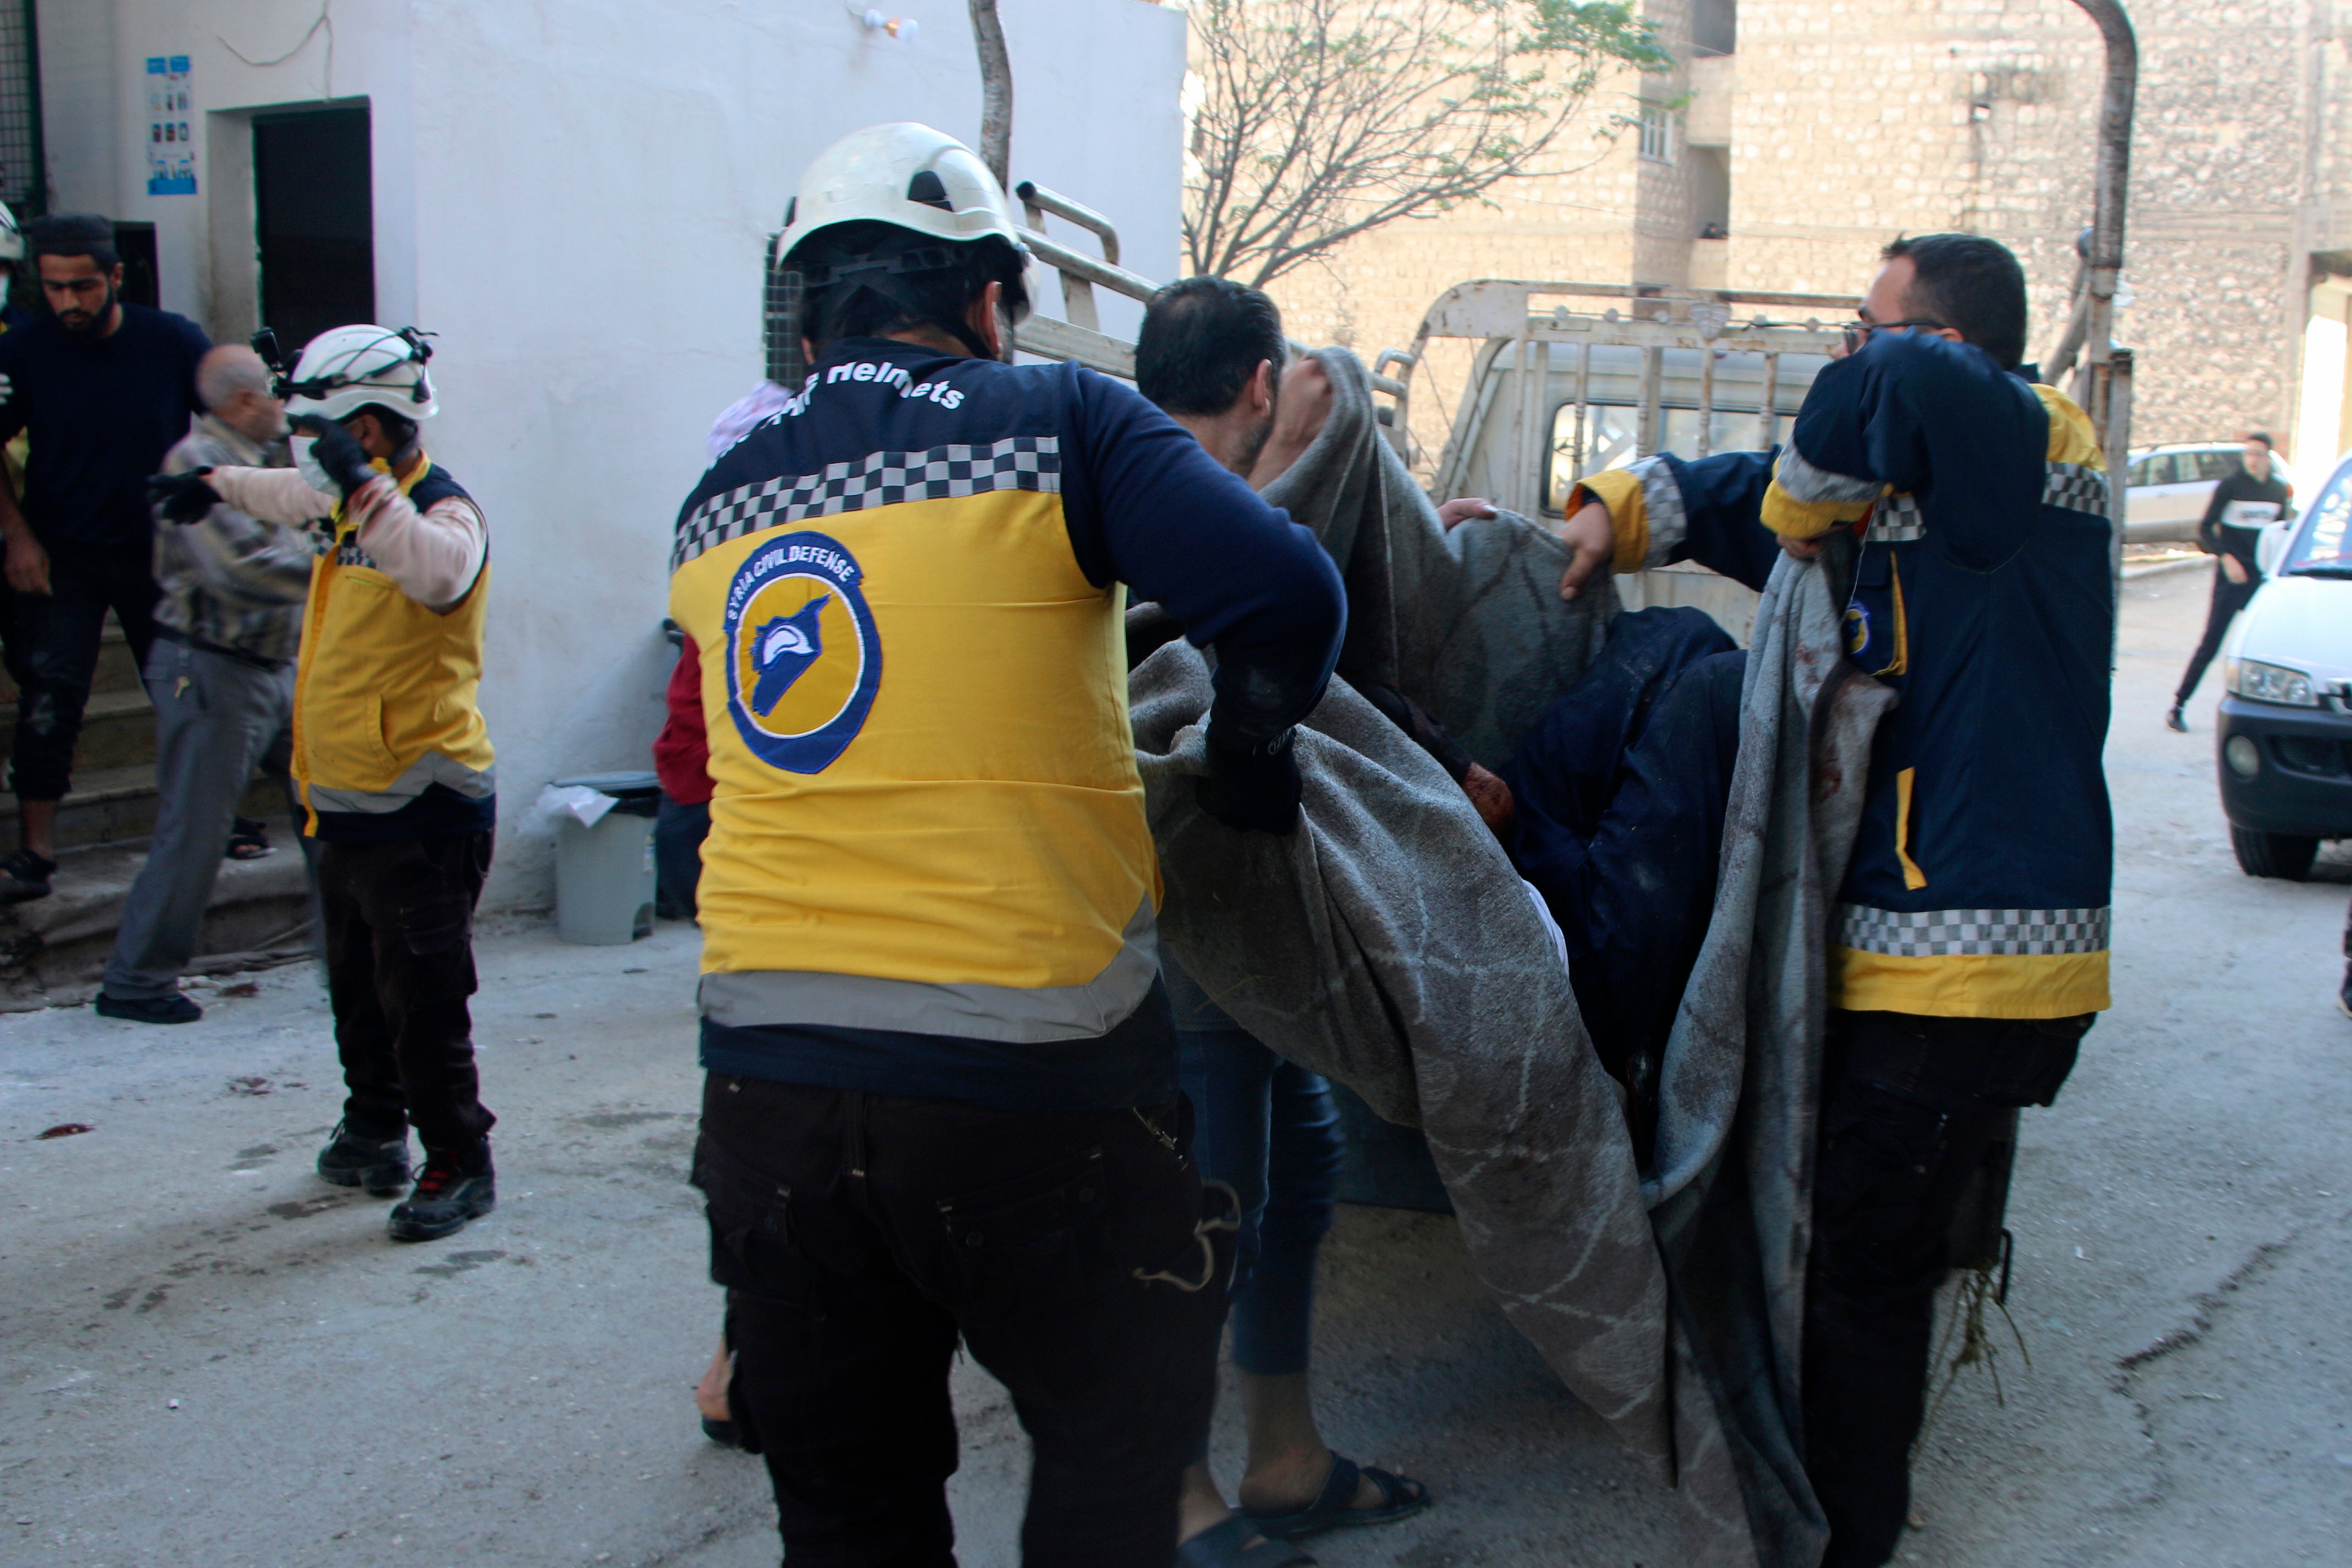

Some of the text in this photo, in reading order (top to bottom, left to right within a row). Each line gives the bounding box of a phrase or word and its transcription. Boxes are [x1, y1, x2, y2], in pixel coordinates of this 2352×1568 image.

[727, 545, 854, 620] SYRIA CIVIL DEFENSE
